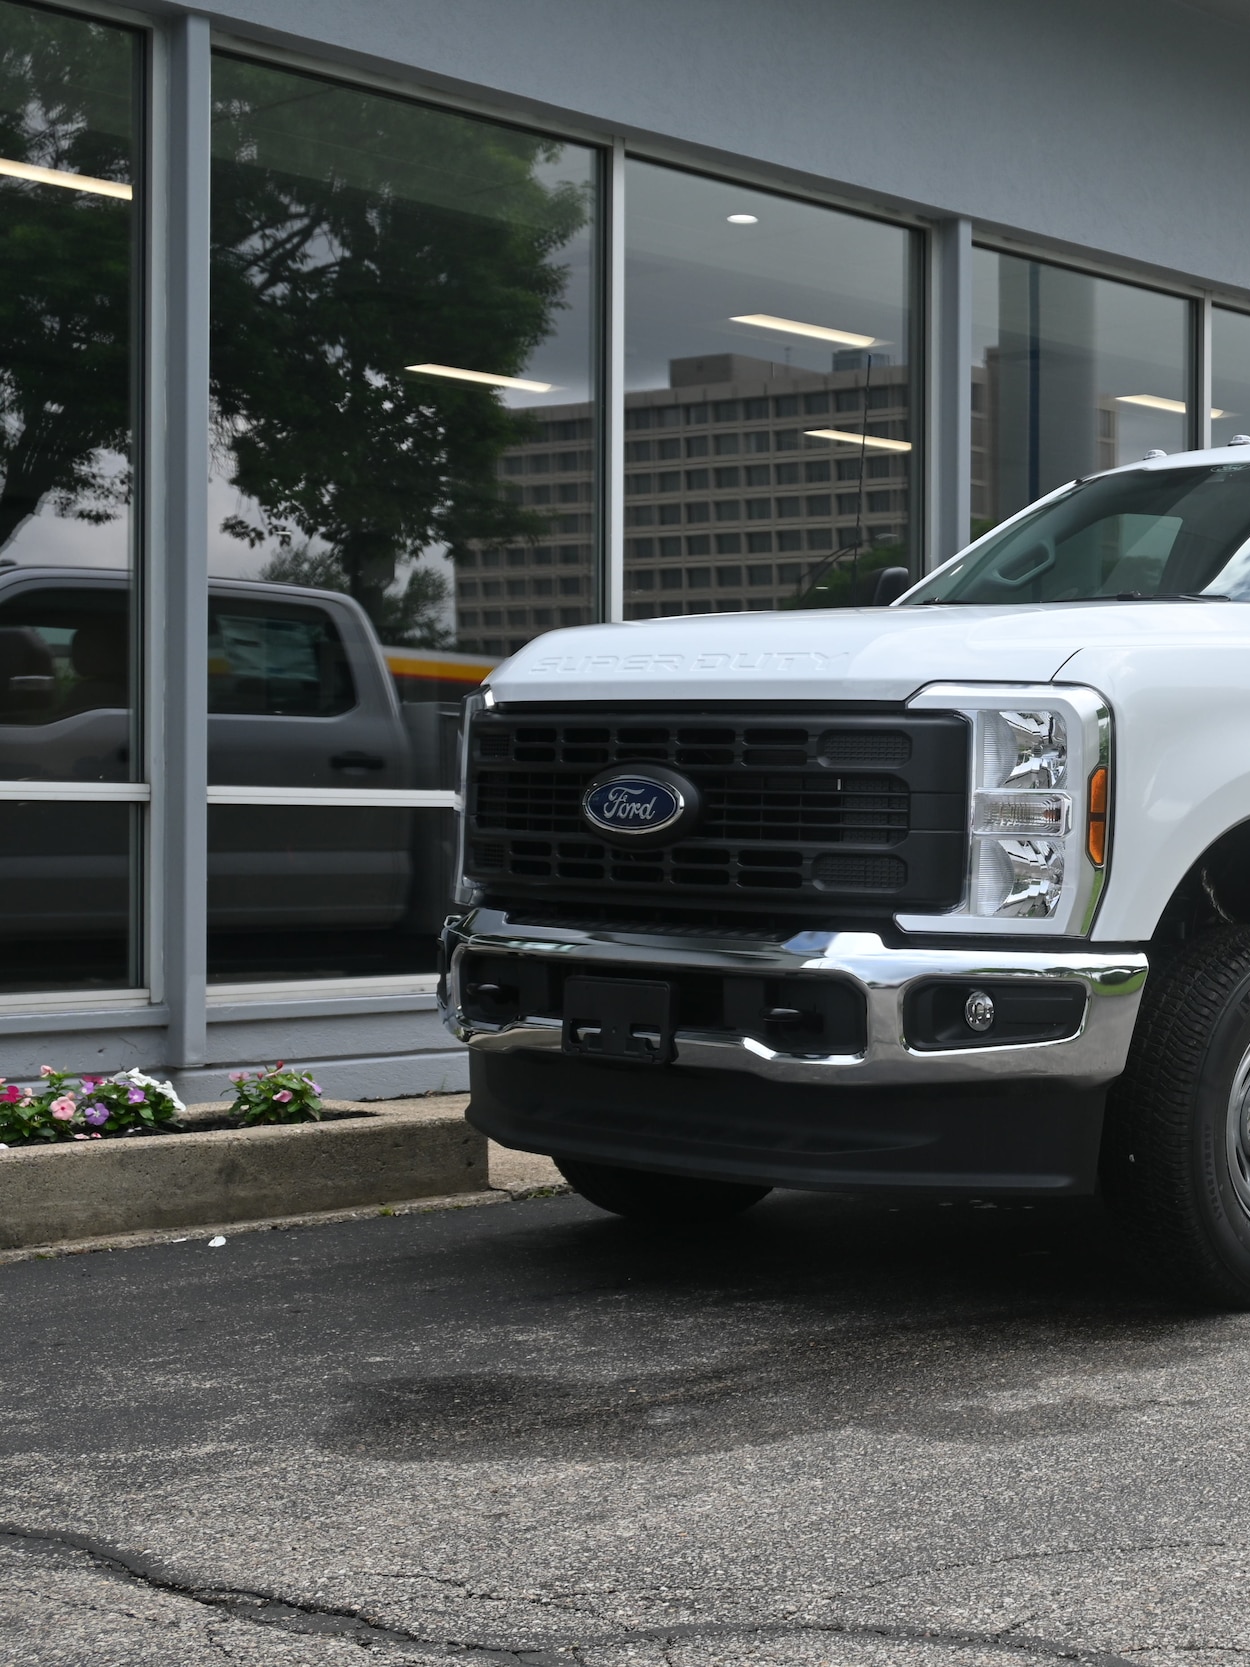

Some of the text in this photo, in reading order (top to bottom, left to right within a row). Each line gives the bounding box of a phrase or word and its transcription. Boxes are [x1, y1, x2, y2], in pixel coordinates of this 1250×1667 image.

[530, 651, 848, 675] SUPER DUTY
[603, 786, 658, 820] Ford
